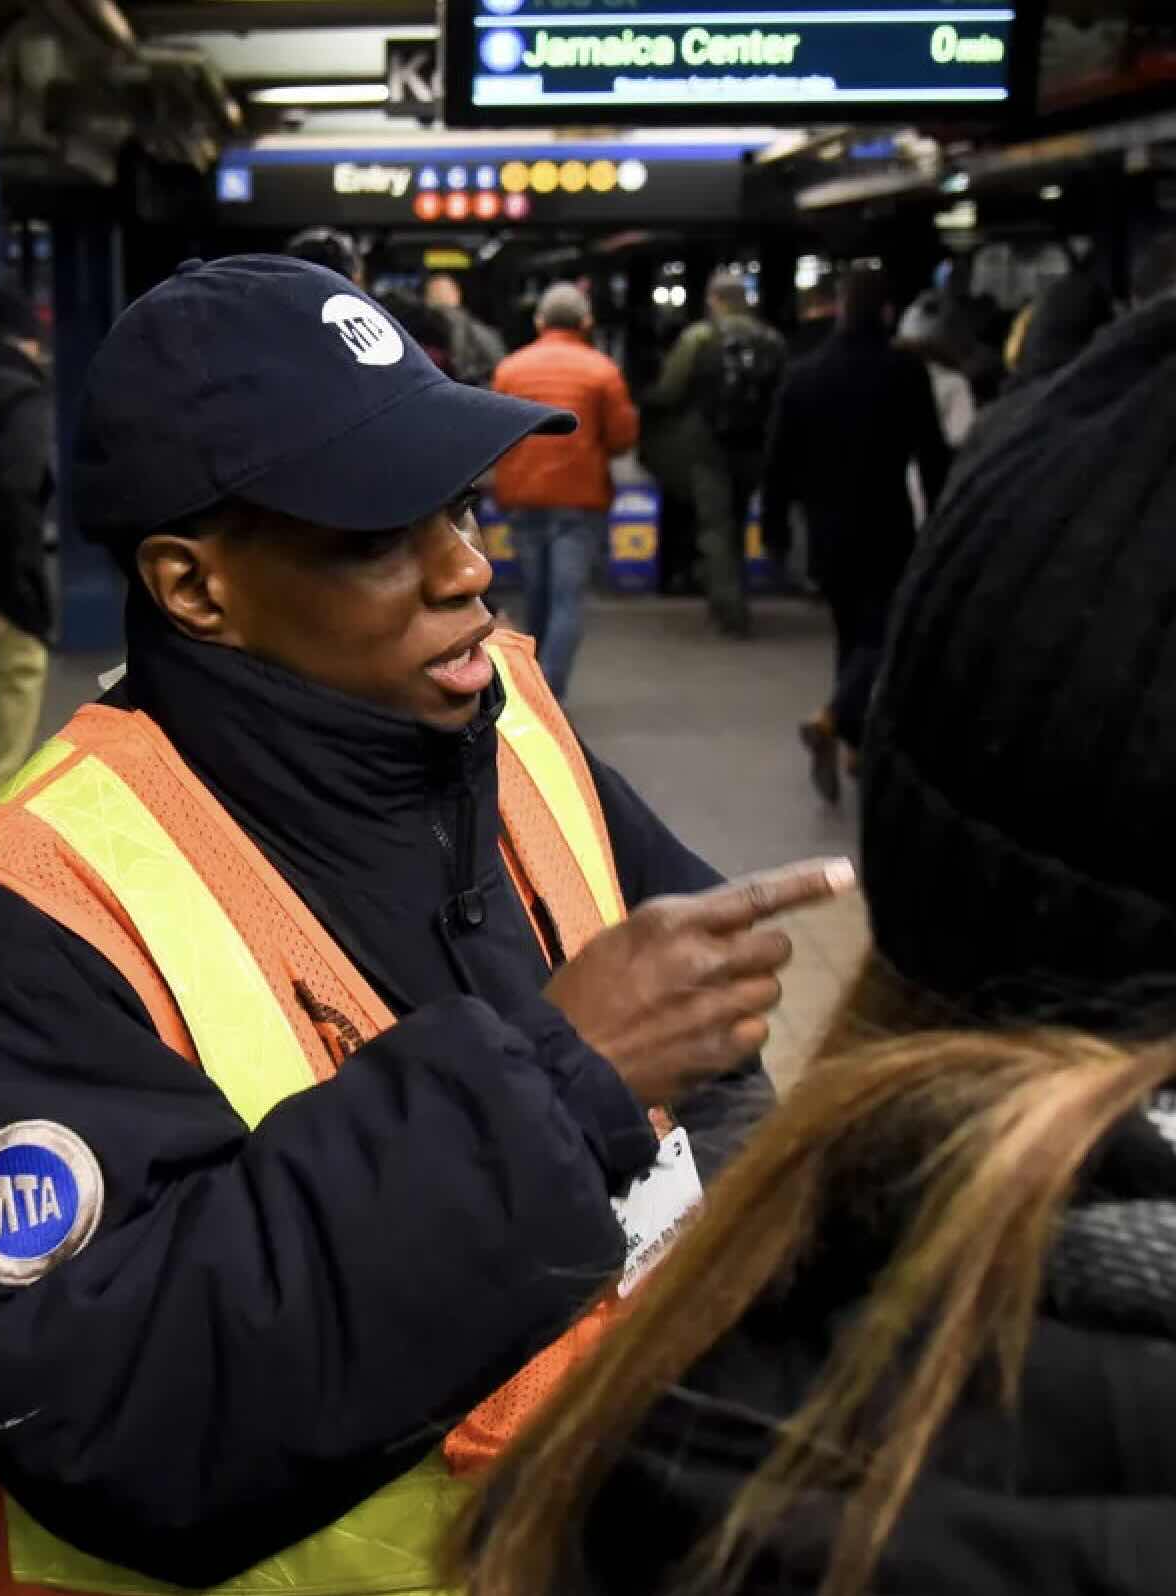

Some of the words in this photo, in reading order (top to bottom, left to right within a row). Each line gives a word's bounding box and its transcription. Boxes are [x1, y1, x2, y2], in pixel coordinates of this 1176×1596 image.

[523, 28, 675, 67] Jamaica
[681, 26, 801, 65] Center
[333, 163, 413, 197] Entry
